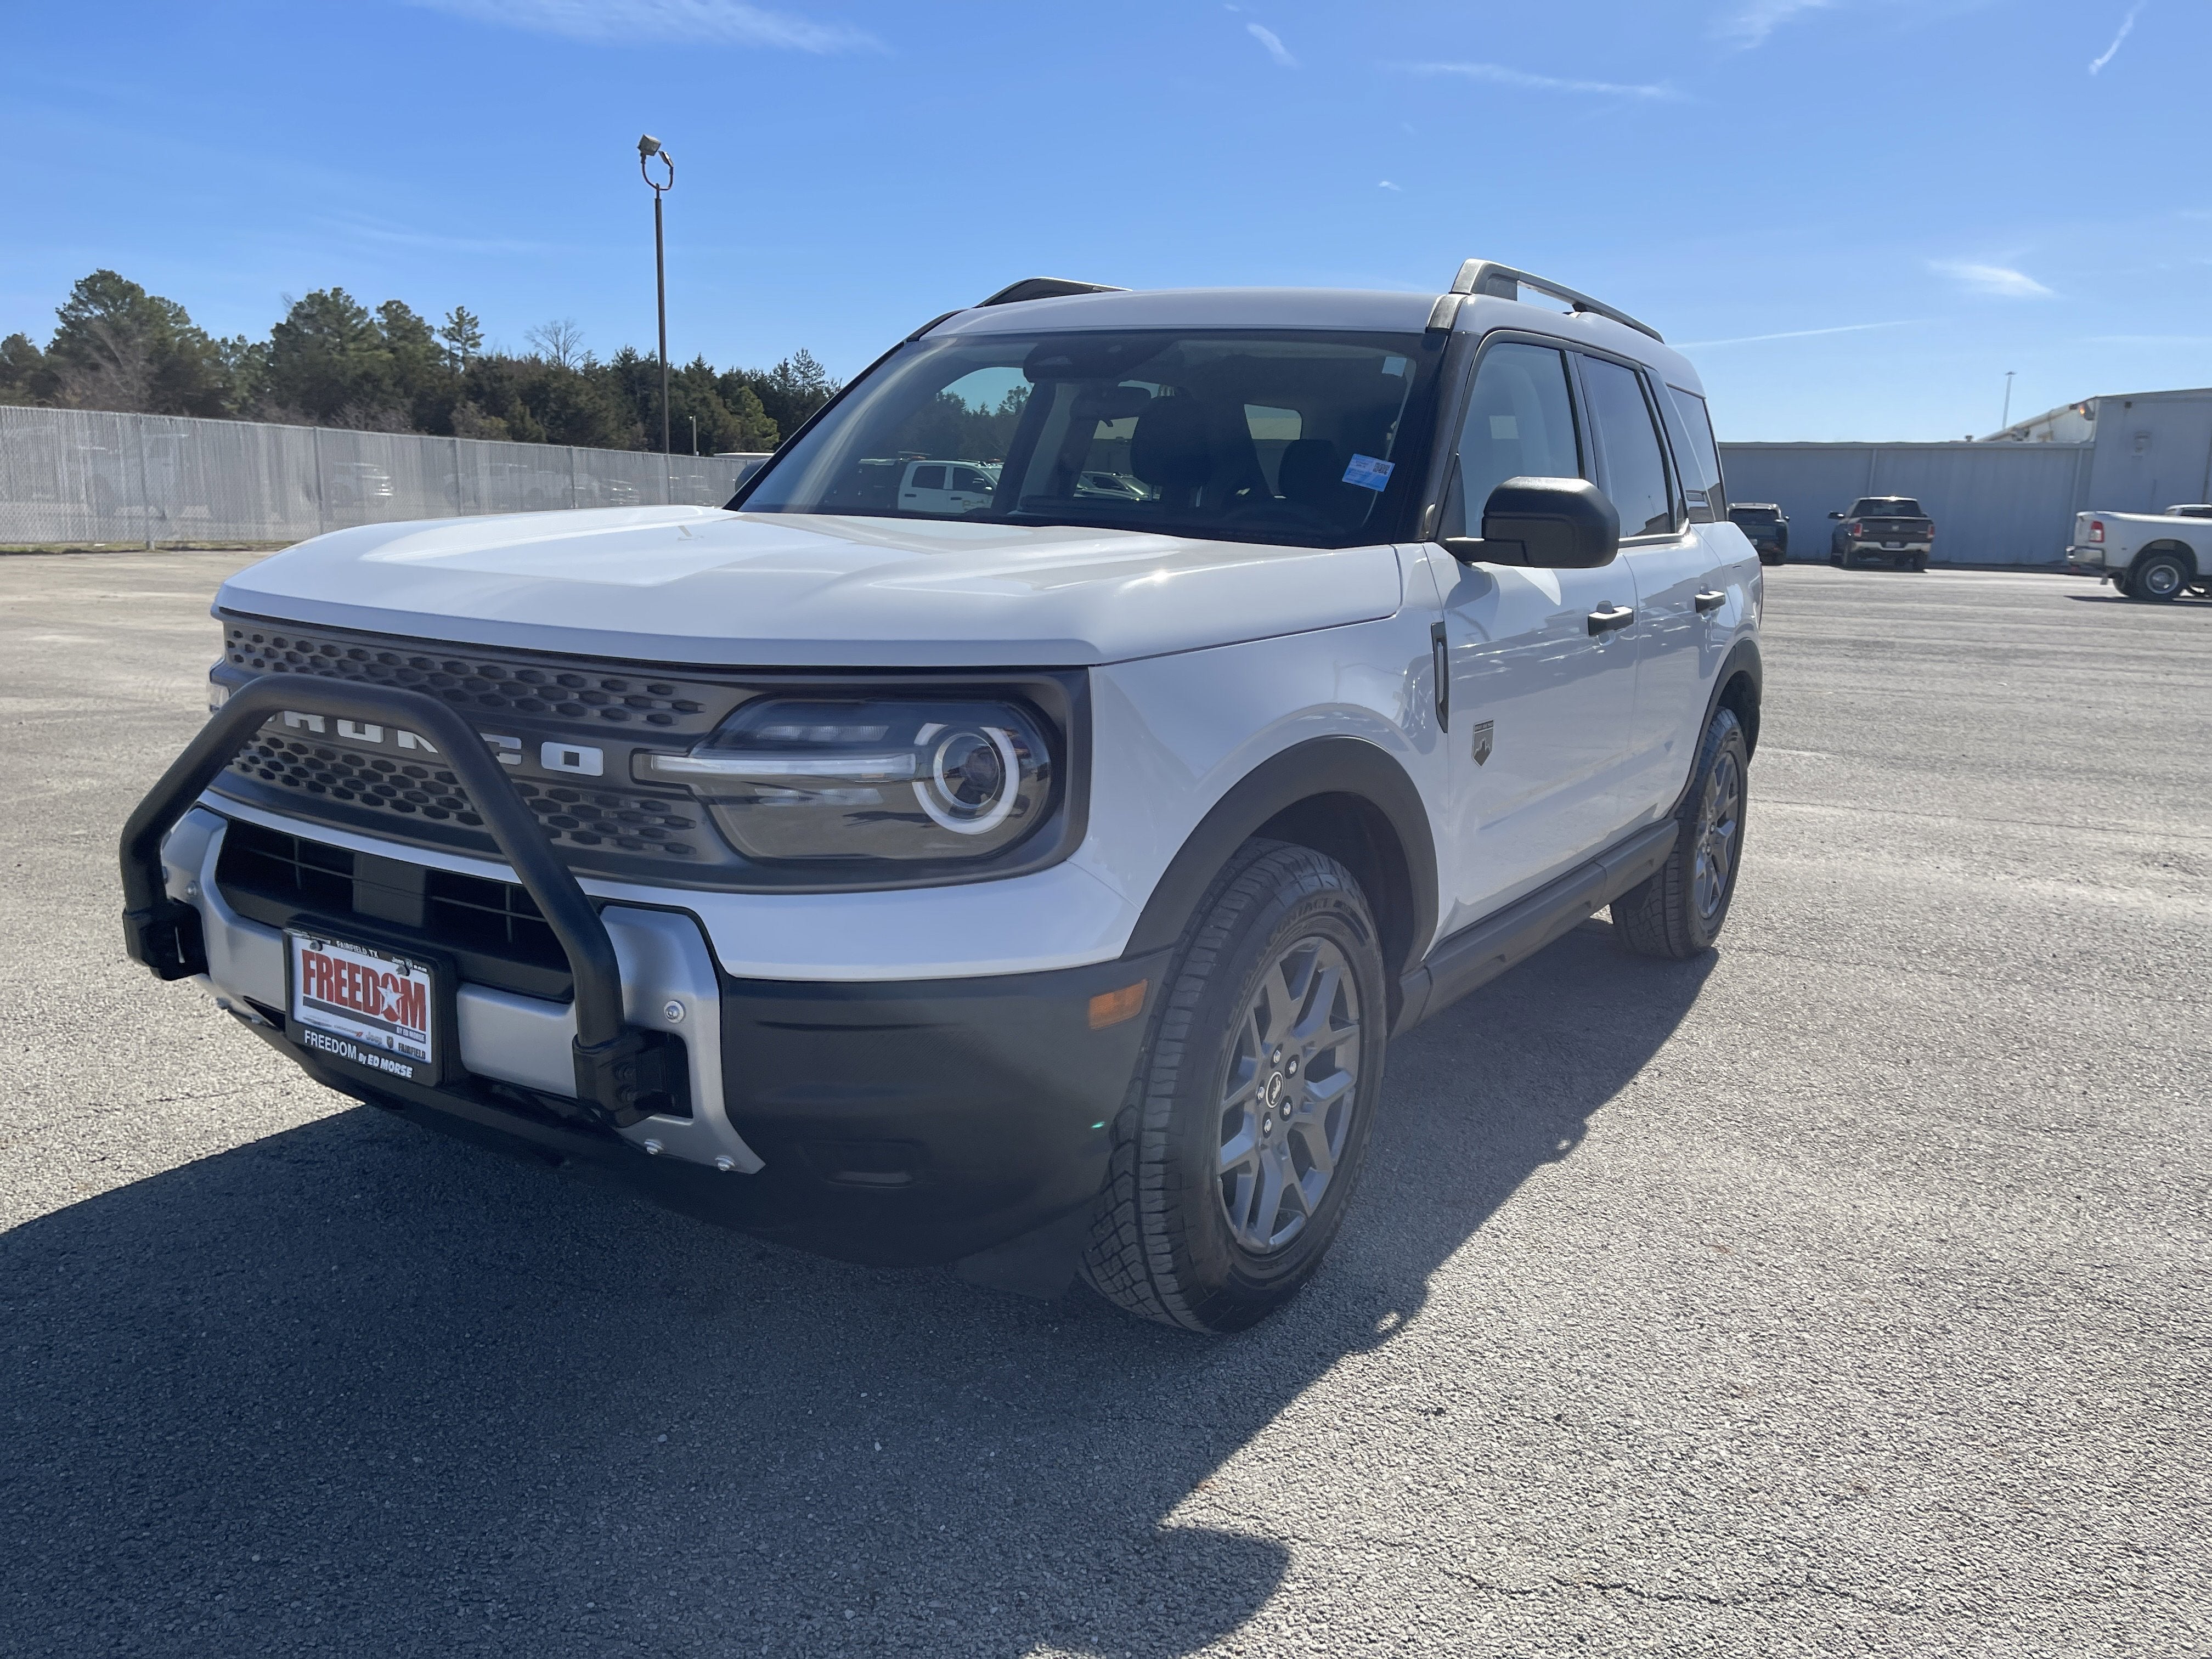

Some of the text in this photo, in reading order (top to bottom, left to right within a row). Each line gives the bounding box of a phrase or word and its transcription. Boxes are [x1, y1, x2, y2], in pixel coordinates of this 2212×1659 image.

[267, 711, 603, 777] ROCO
[302, 949, 426, 1031] FREEDOM
[304, 1030, 357, 1060] FREEDOM
[368, 1053, 380, 1067] ED
[381, 1059, 413, 1079] MORSE
